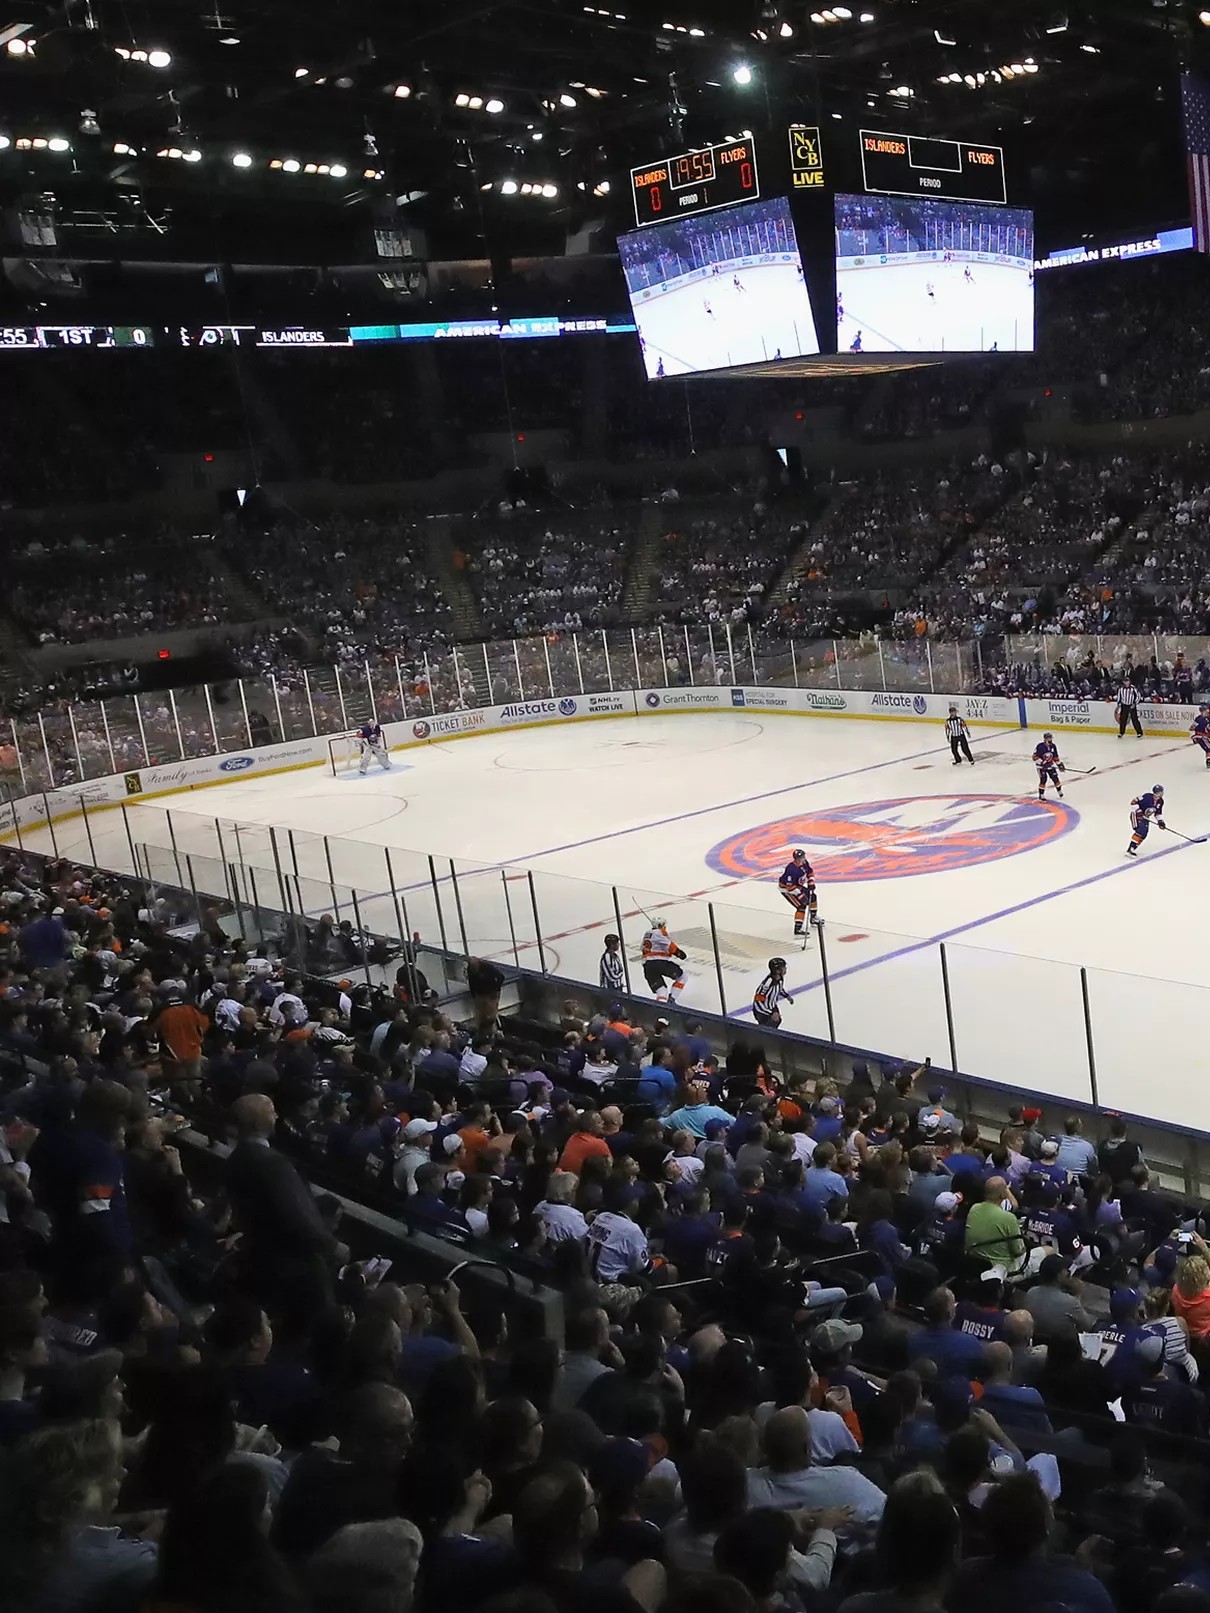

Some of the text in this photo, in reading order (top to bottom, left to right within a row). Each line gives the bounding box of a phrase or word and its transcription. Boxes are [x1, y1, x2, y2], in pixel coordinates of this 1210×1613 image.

[864, 138, 906, 154] ISLANDERS
[720, 147, 747, 165] FLYERS
[968, 151, 995, 165] FLYERS
[676, 152, 712, 184] 19:55
[740, 163, 752, 188] 0
[634, 169, 667, 188] ISLANDERS
[793, 171, 824, 185] LIVE
[919, 177, 942, 189] PERIOD
[650, 186, 661, 211] 0
[679, 194, 698, 207] PERIOD
[1034, 250, 1099, 270] AMERICAN
[1101, 239, 1161, 258] EXPRESS
[59, 328, 92, 344] 1ST
[434, 318, 605, 338] AMERICAN EXPRESS
[132, 328, 146, 345] 0
[262, 331, 325, 344] ISLANDERS
[588, 703, 623, 713] WATCH LIVE
[871, 694, 911, 707] Allstate
[1048, 702, 1090, 714] Imperial
[500, 701, 556, 718] Allstate
[1137, 709, 1195, 720] CKETS ON SALE NOW
[431, 718, 460, 732] TICKET
[462, 713, 485, 727] BANK
[1050, 715, 1091, 725] Bag & Paper
[225, 758, 249, 771] Ford
[147, 765, 189, 785] Family
[961, 1319, 996, 1339] BOSSY
